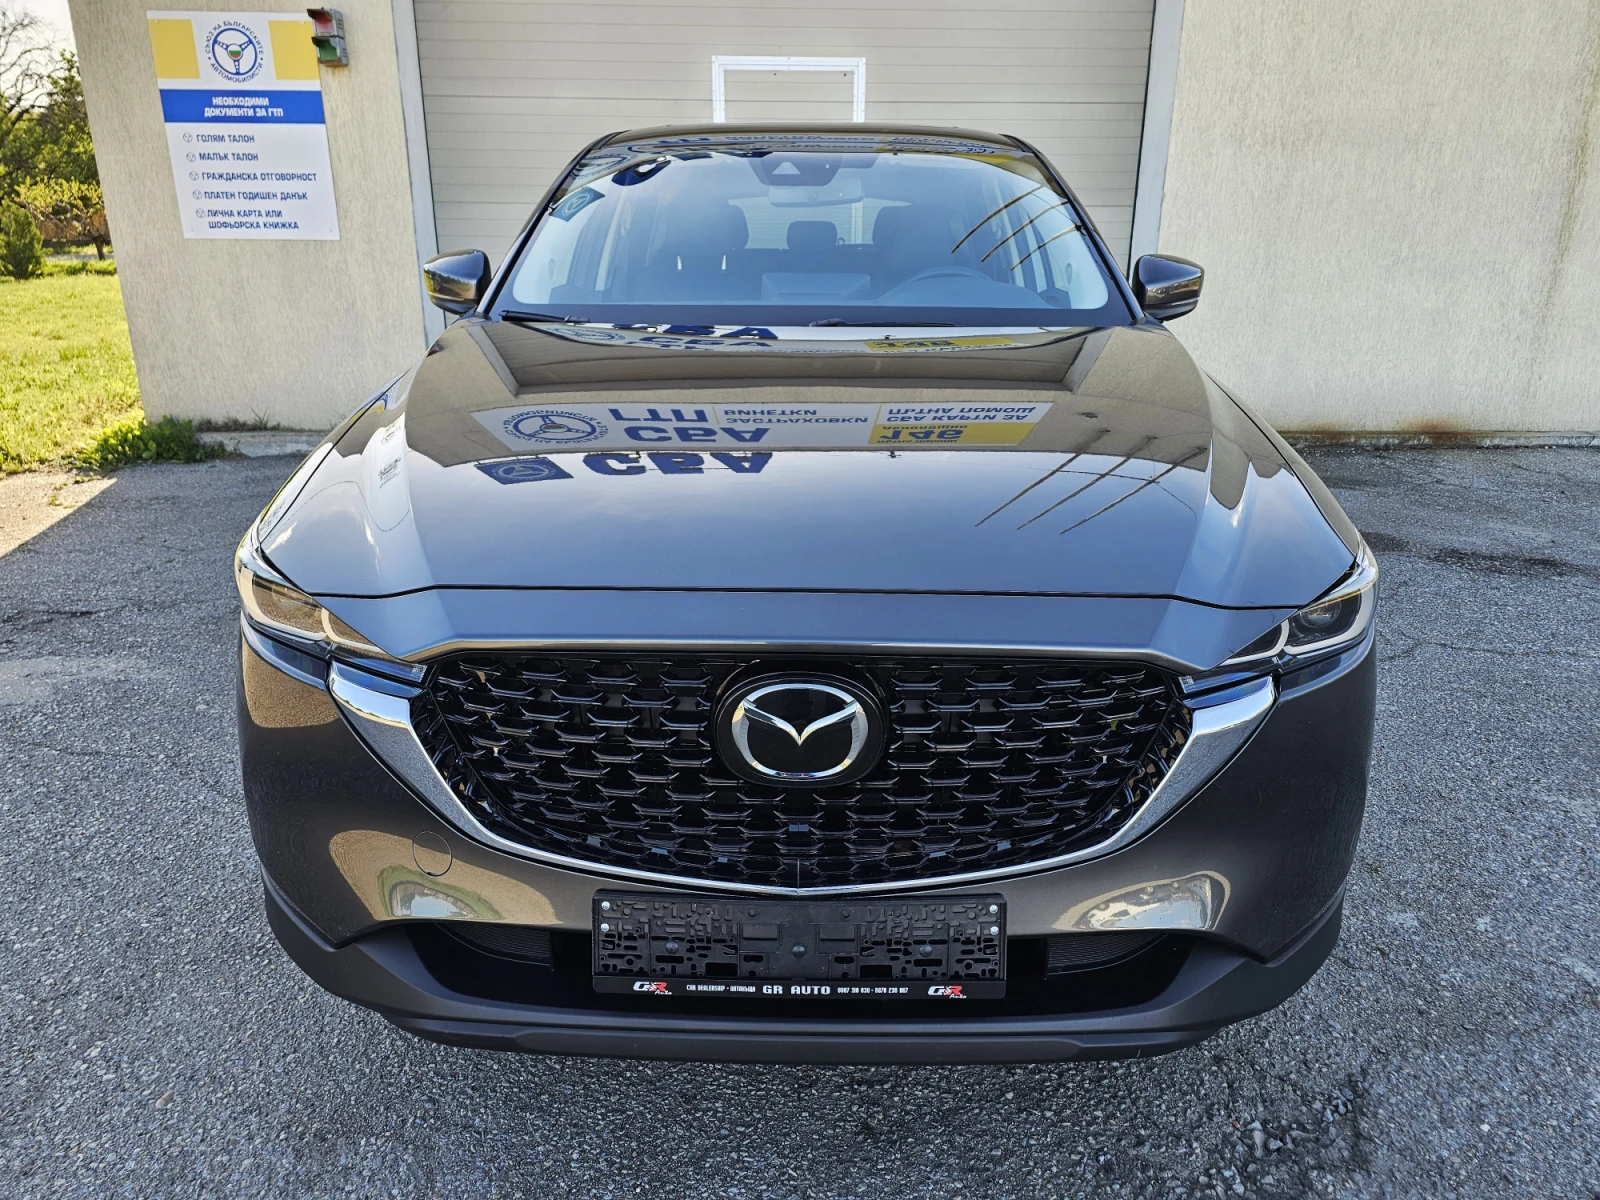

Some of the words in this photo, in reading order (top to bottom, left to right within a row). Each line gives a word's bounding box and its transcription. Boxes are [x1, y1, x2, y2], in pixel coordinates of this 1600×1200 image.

[205, 31, 215, 54] СЪЮЗ
[213, 23, 222, 32] НА
[223, 20, 264, 55] БЪЛГАРСКИТЕ
[210, 62, 263, 84] АВТОМОБИЛИСТИ
[212, 97, 269, 107] НЕОБХОДИМИ
[204, 107, 254, 118] ДОКУМЕНТИ
[256, 108, 267, 117] ЗА
[268, 108, 283, 117] ГТП
[196, 134, 226, 143] ГОЛЯМ
[227, 134, 255, 143] ТАЛОН
[199, 152, 230, 161] МАЛЪК
[231, 152, 259, 161] ТАЛОН
[202, 172, 258, 182] ГРАЖДАНСКА
[260, 172, 317, 181] ОТГОВОРНОСТ
[204, 191, 236, 200] ПЛАТЕН
[237, 191, 278, 201] ГОДИШЕН
[280, 192, 308, 201] ДАНЪК
[207, 209, 235, 218] ЛИЧНА
[237, 209, 263, 218] КАРТА
[265, 209, 282, 218] ИЛИ
[209, 221, 261, 230] ШОФЬОРСКА
[263, 221, 299, 230] КНИЖКА
[697, 984, 726, 992] DEALERSHIP
[762, 985, 783, 994] GR
[790, 985, 831, 995] AUTO
